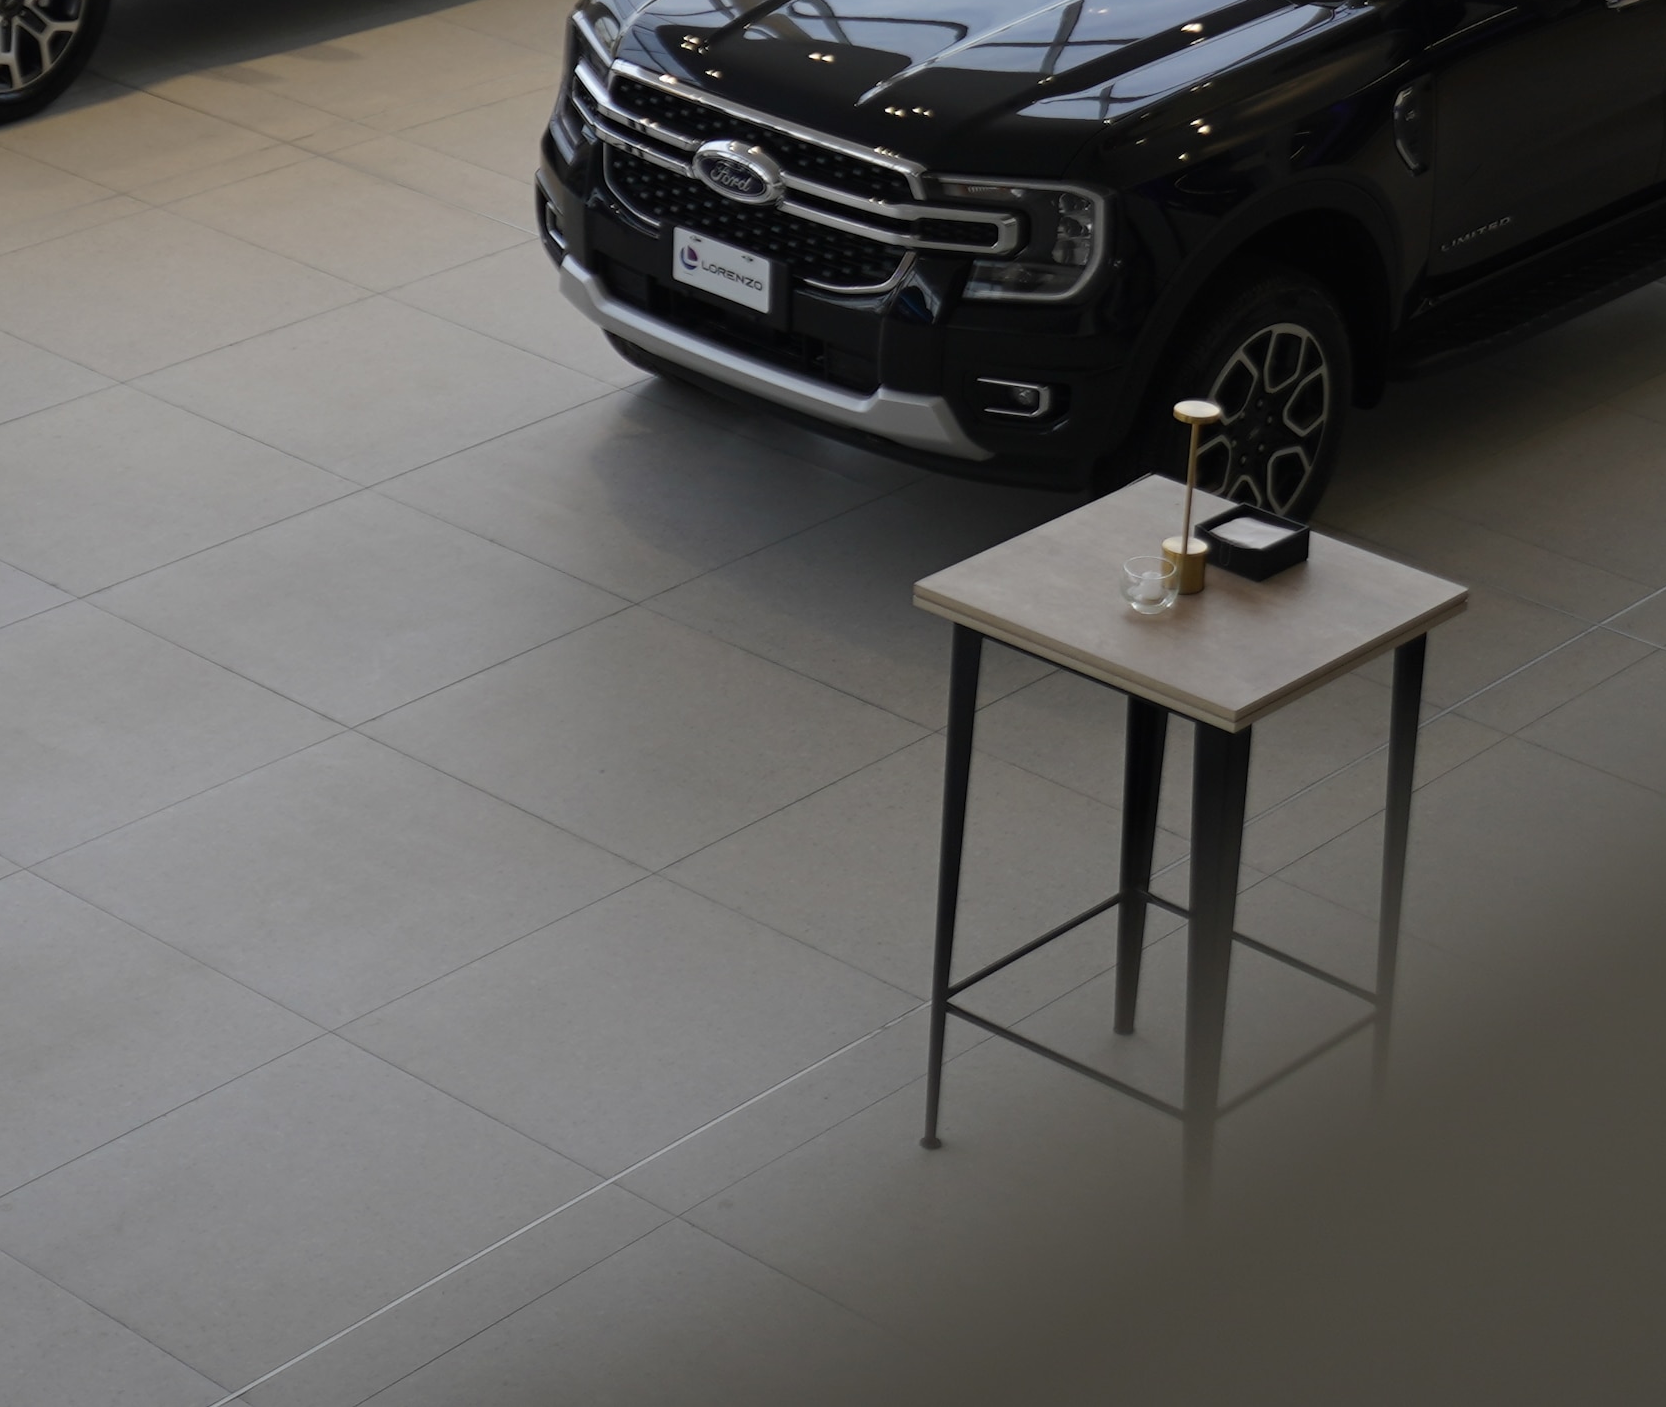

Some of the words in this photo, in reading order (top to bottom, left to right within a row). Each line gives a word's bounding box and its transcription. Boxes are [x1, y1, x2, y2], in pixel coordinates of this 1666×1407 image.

[709, 162, 753, 192] Ford
[1441, 216, 1511, 252] LIMITED
[701, 260, 763, 291] LORENZO
